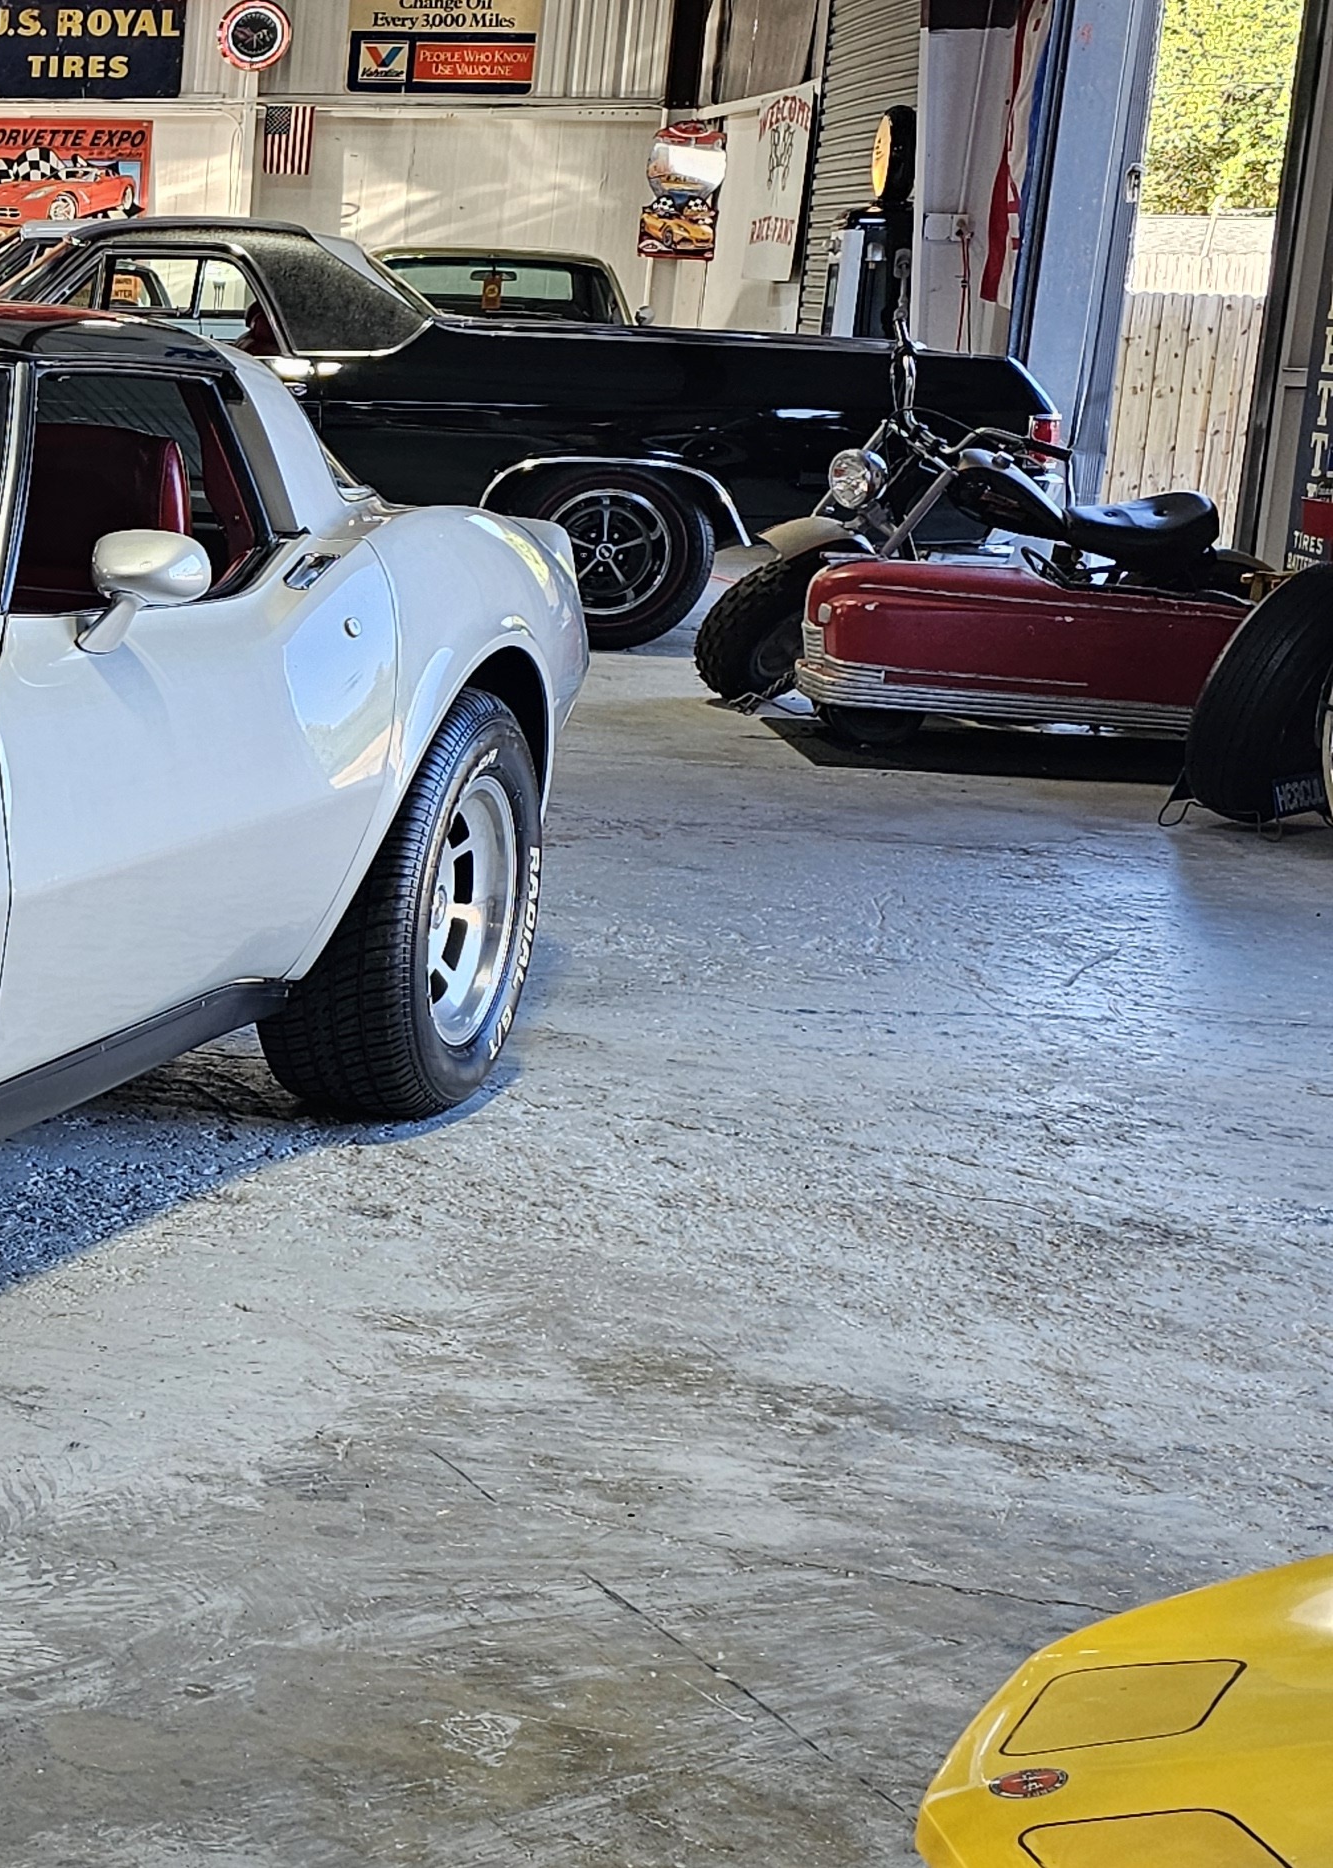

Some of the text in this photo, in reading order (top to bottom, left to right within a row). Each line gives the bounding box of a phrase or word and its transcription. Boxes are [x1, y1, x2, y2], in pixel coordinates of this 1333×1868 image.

[57, 9, 180, 37] ROYAL
[373, 11, 515, 30] Every 3,000 Miles
[27, 55, 129, 78] TIRES
[759, 95, 811, 142] WELCOME
[90, 129, 146, 147] EXPO
[1293, 530, 1324, 555] TIRES
[511, 845, 541, 990] RADIAL
